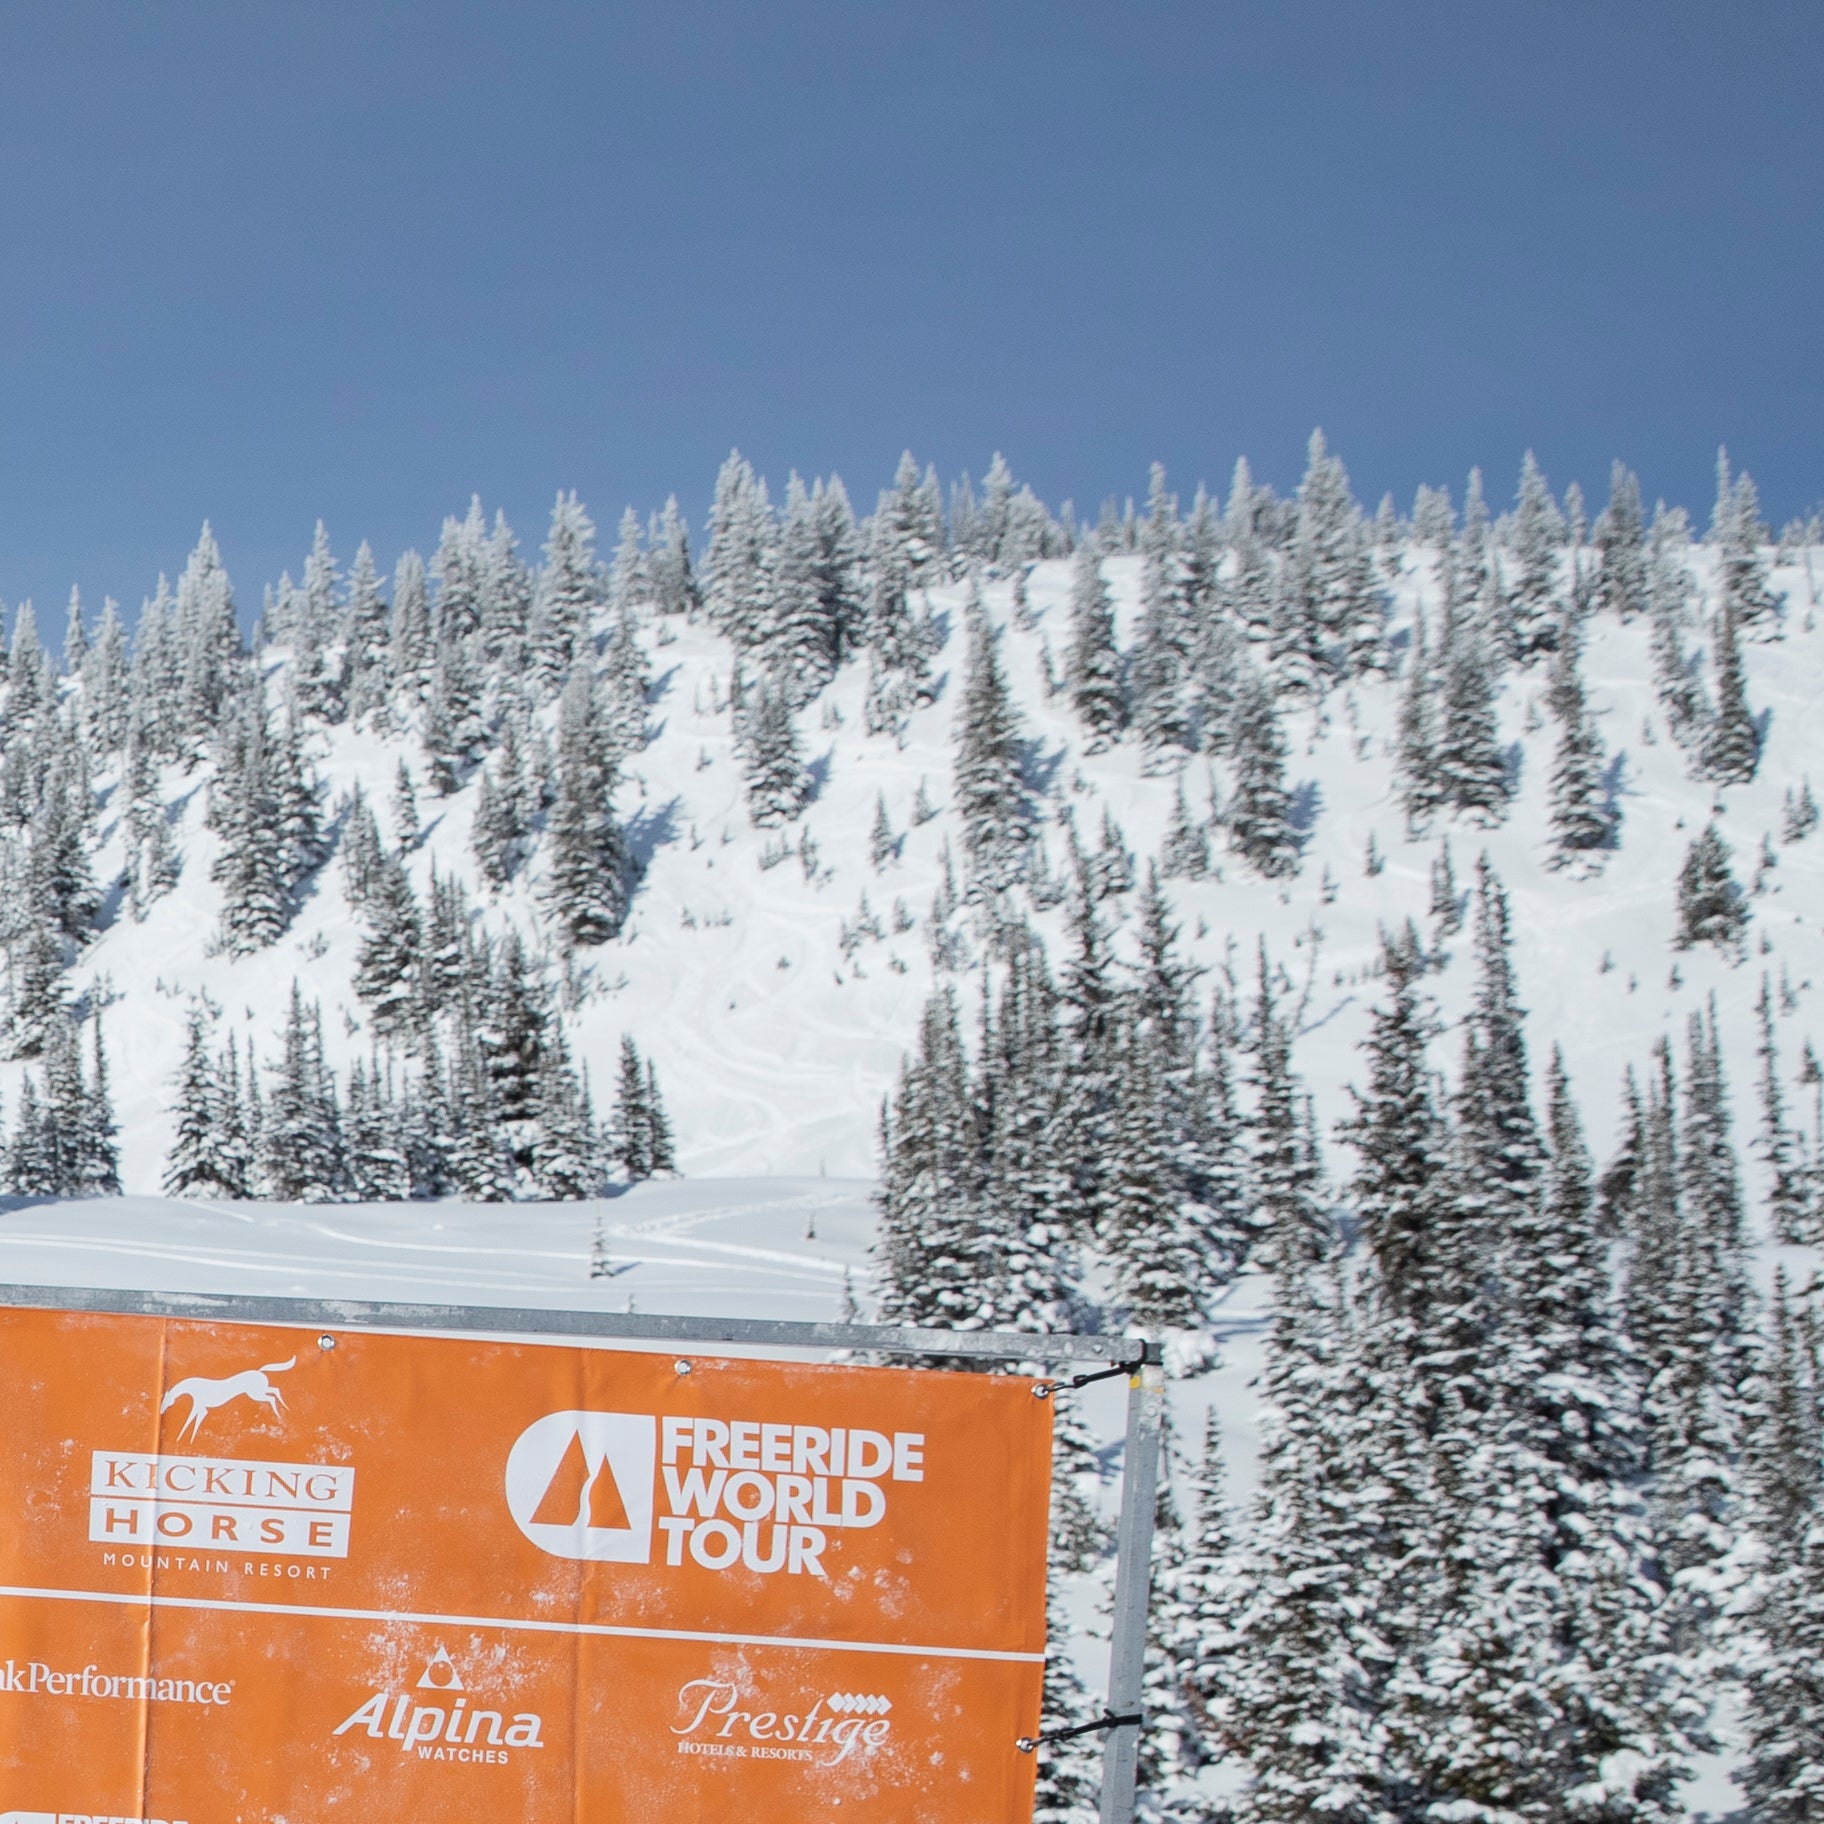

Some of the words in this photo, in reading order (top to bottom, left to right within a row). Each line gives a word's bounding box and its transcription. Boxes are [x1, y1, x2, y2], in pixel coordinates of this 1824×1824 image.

[661, 1416, 924, 1482] FREERIDE
[107, 1460, 339, 1501] KICKING
[661, 1465, 886, 1528] WORLD
[107, 1508, 333, 1547] HORSE
[659, 1517, 826, 1576] TOUR
[103, 1553, 228, 1574] MOUNTAIN
[244, 1560, 332, 1580] RESORT
[332, 1692, 543, 1752] Alpina
[671, 1679, 892, 1767] Prestige
[417, 1747, 508, 1764] WATCHES
[677, 1743, 734, 1757] HOTELS
[751, 1746, 812, 1761] RESORTS
